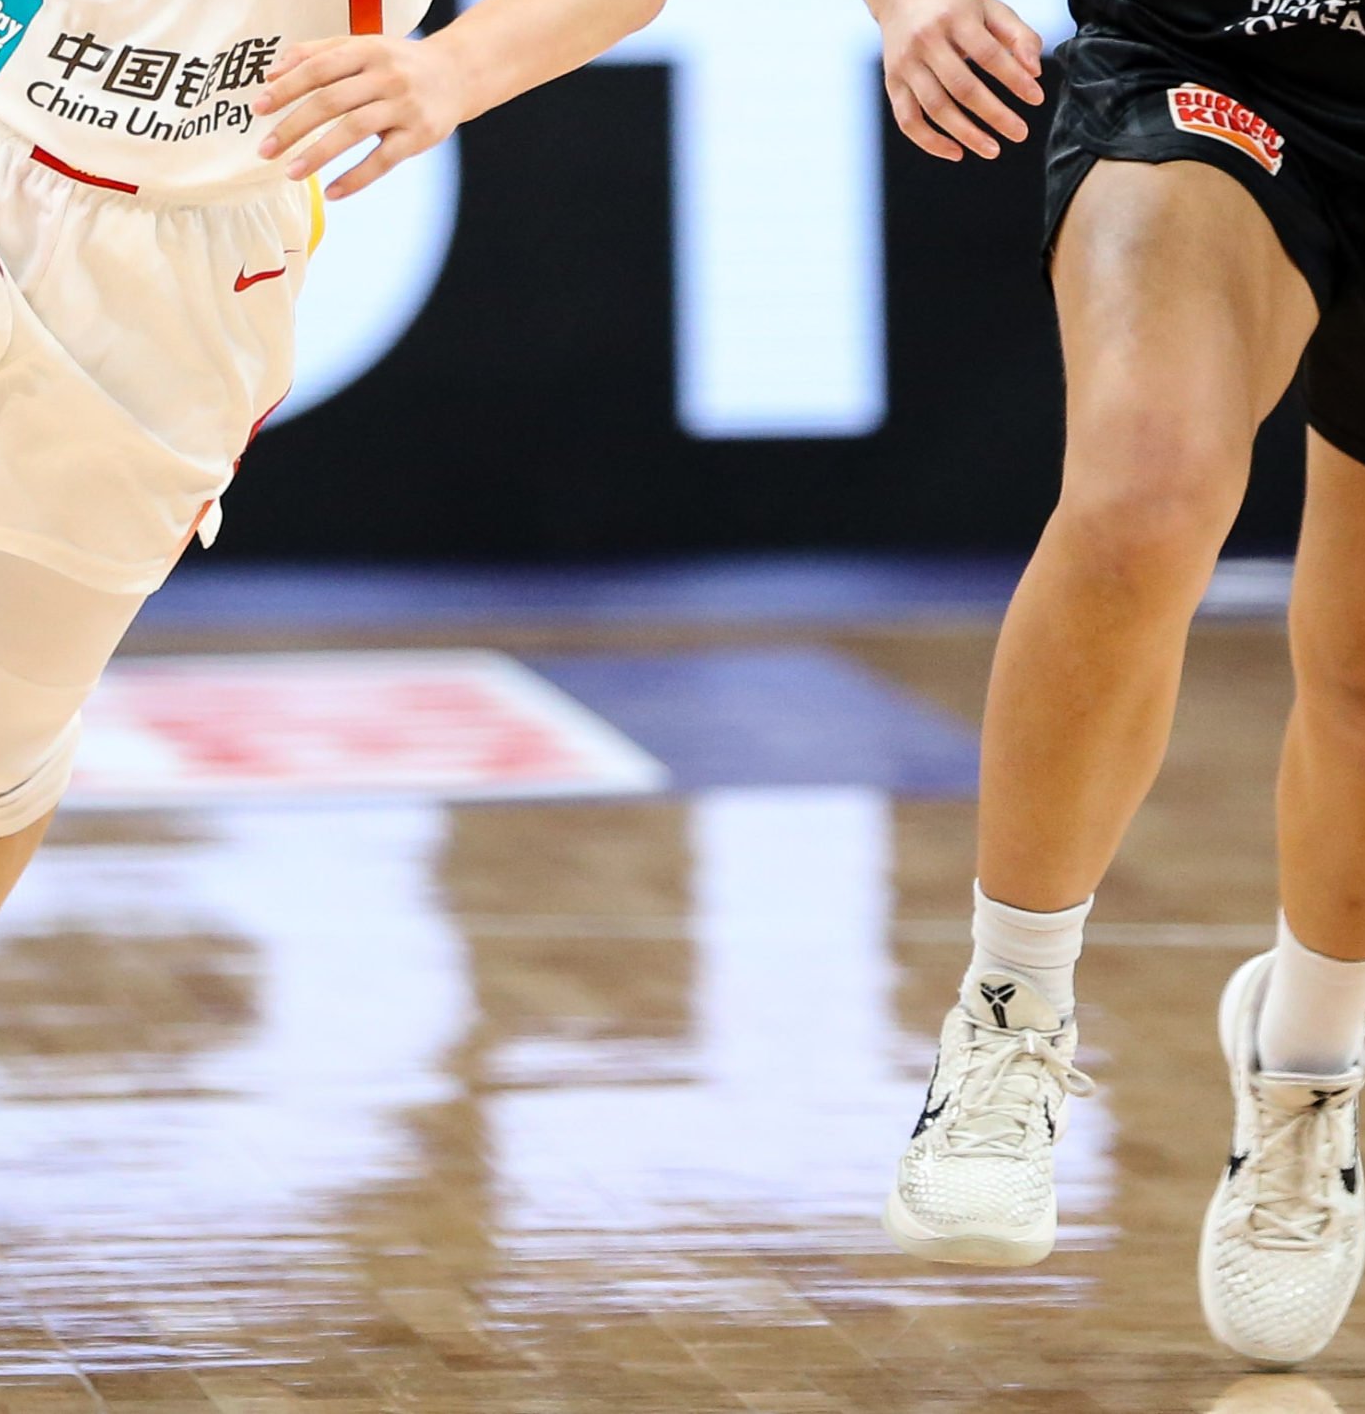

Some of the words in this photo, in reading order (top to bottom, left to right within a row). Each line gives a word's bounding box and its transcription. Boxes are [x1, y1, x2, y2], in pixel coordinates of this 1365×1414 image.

[48, 32, 282, 109] 中国银联
[26, 81, 119, 130] China
[126, 100, 254, 142] UnionPay
